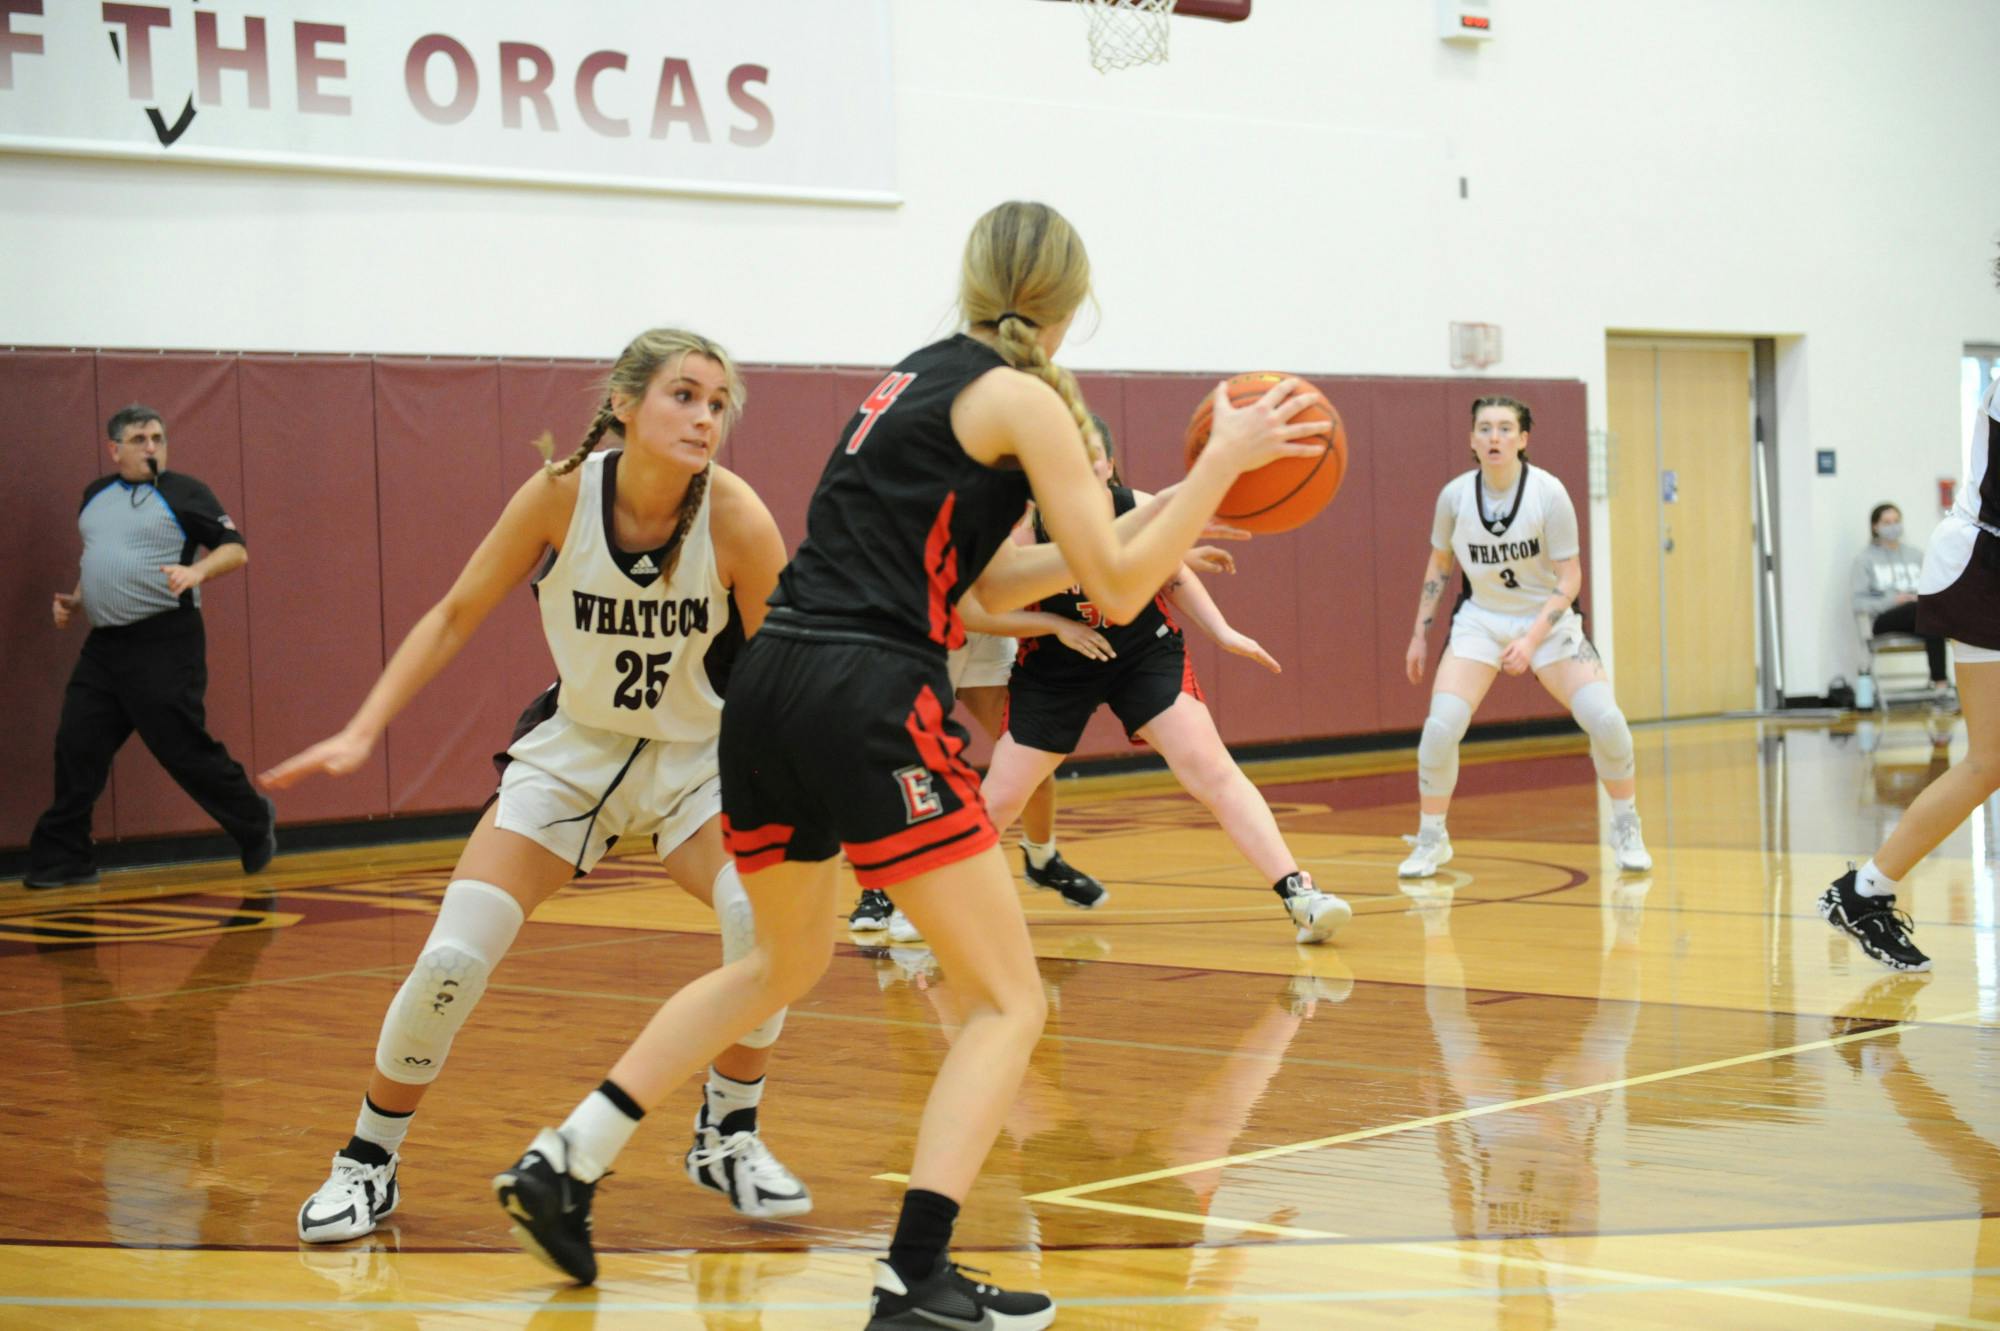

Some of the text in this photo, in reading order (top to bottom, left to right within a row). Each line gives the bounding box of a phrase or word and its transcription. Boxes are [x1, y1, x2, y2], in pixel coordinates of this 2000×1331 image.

[102, 2, 352, 116] THE
[404, 33, 775, 148] ORCAS
[845, 372, 918, 454] 4
[1468, 538, 1540, 564] WHATCOM
[1500, 568, 1520, 588] 3
[613, 650, 672, 710] 25
[892, 764, 944, 825] E
